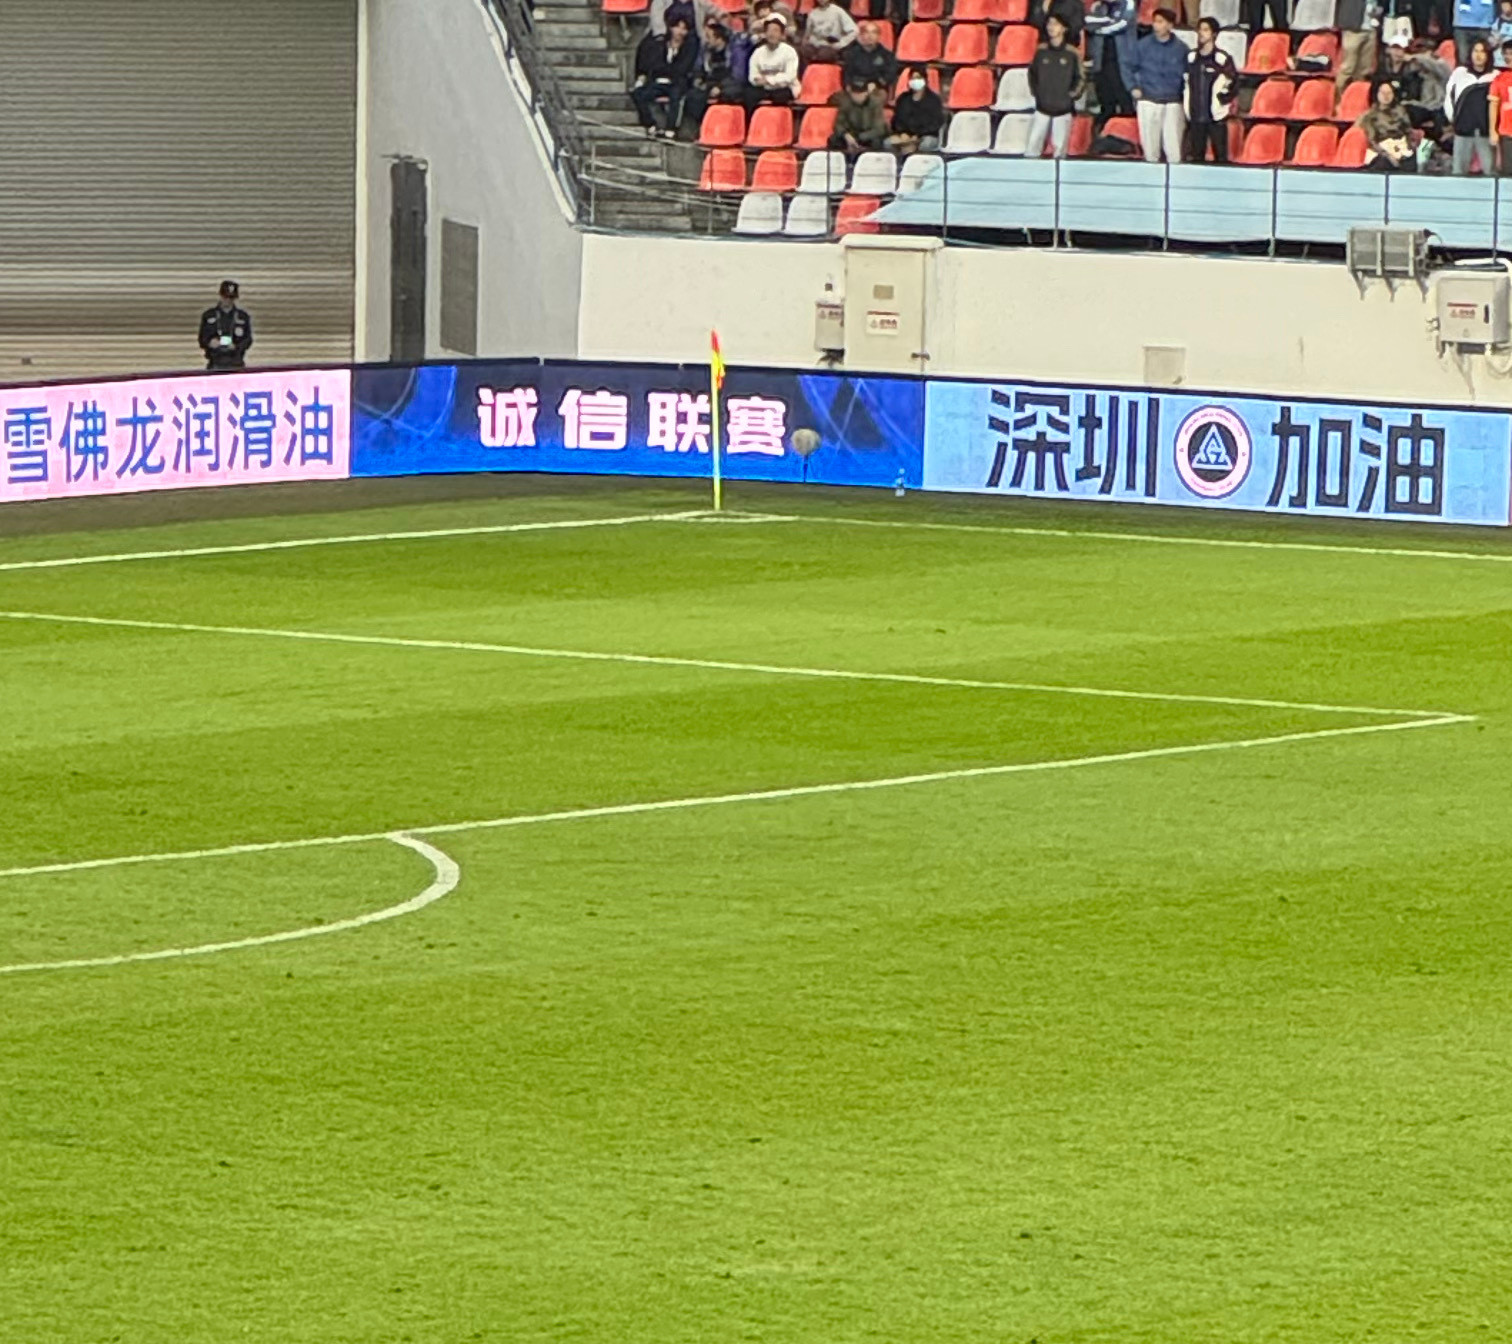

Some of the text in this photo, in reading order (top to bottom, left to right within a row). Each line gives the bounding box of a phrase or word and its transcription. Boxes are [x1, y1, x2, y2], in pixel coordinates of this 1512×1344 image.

[3, 385, 334, 485] 雪佛龙润滑油
[476, 387, 786, 456] 诚信联赛
[987, 387, 1446, 516] 深圳 加油
